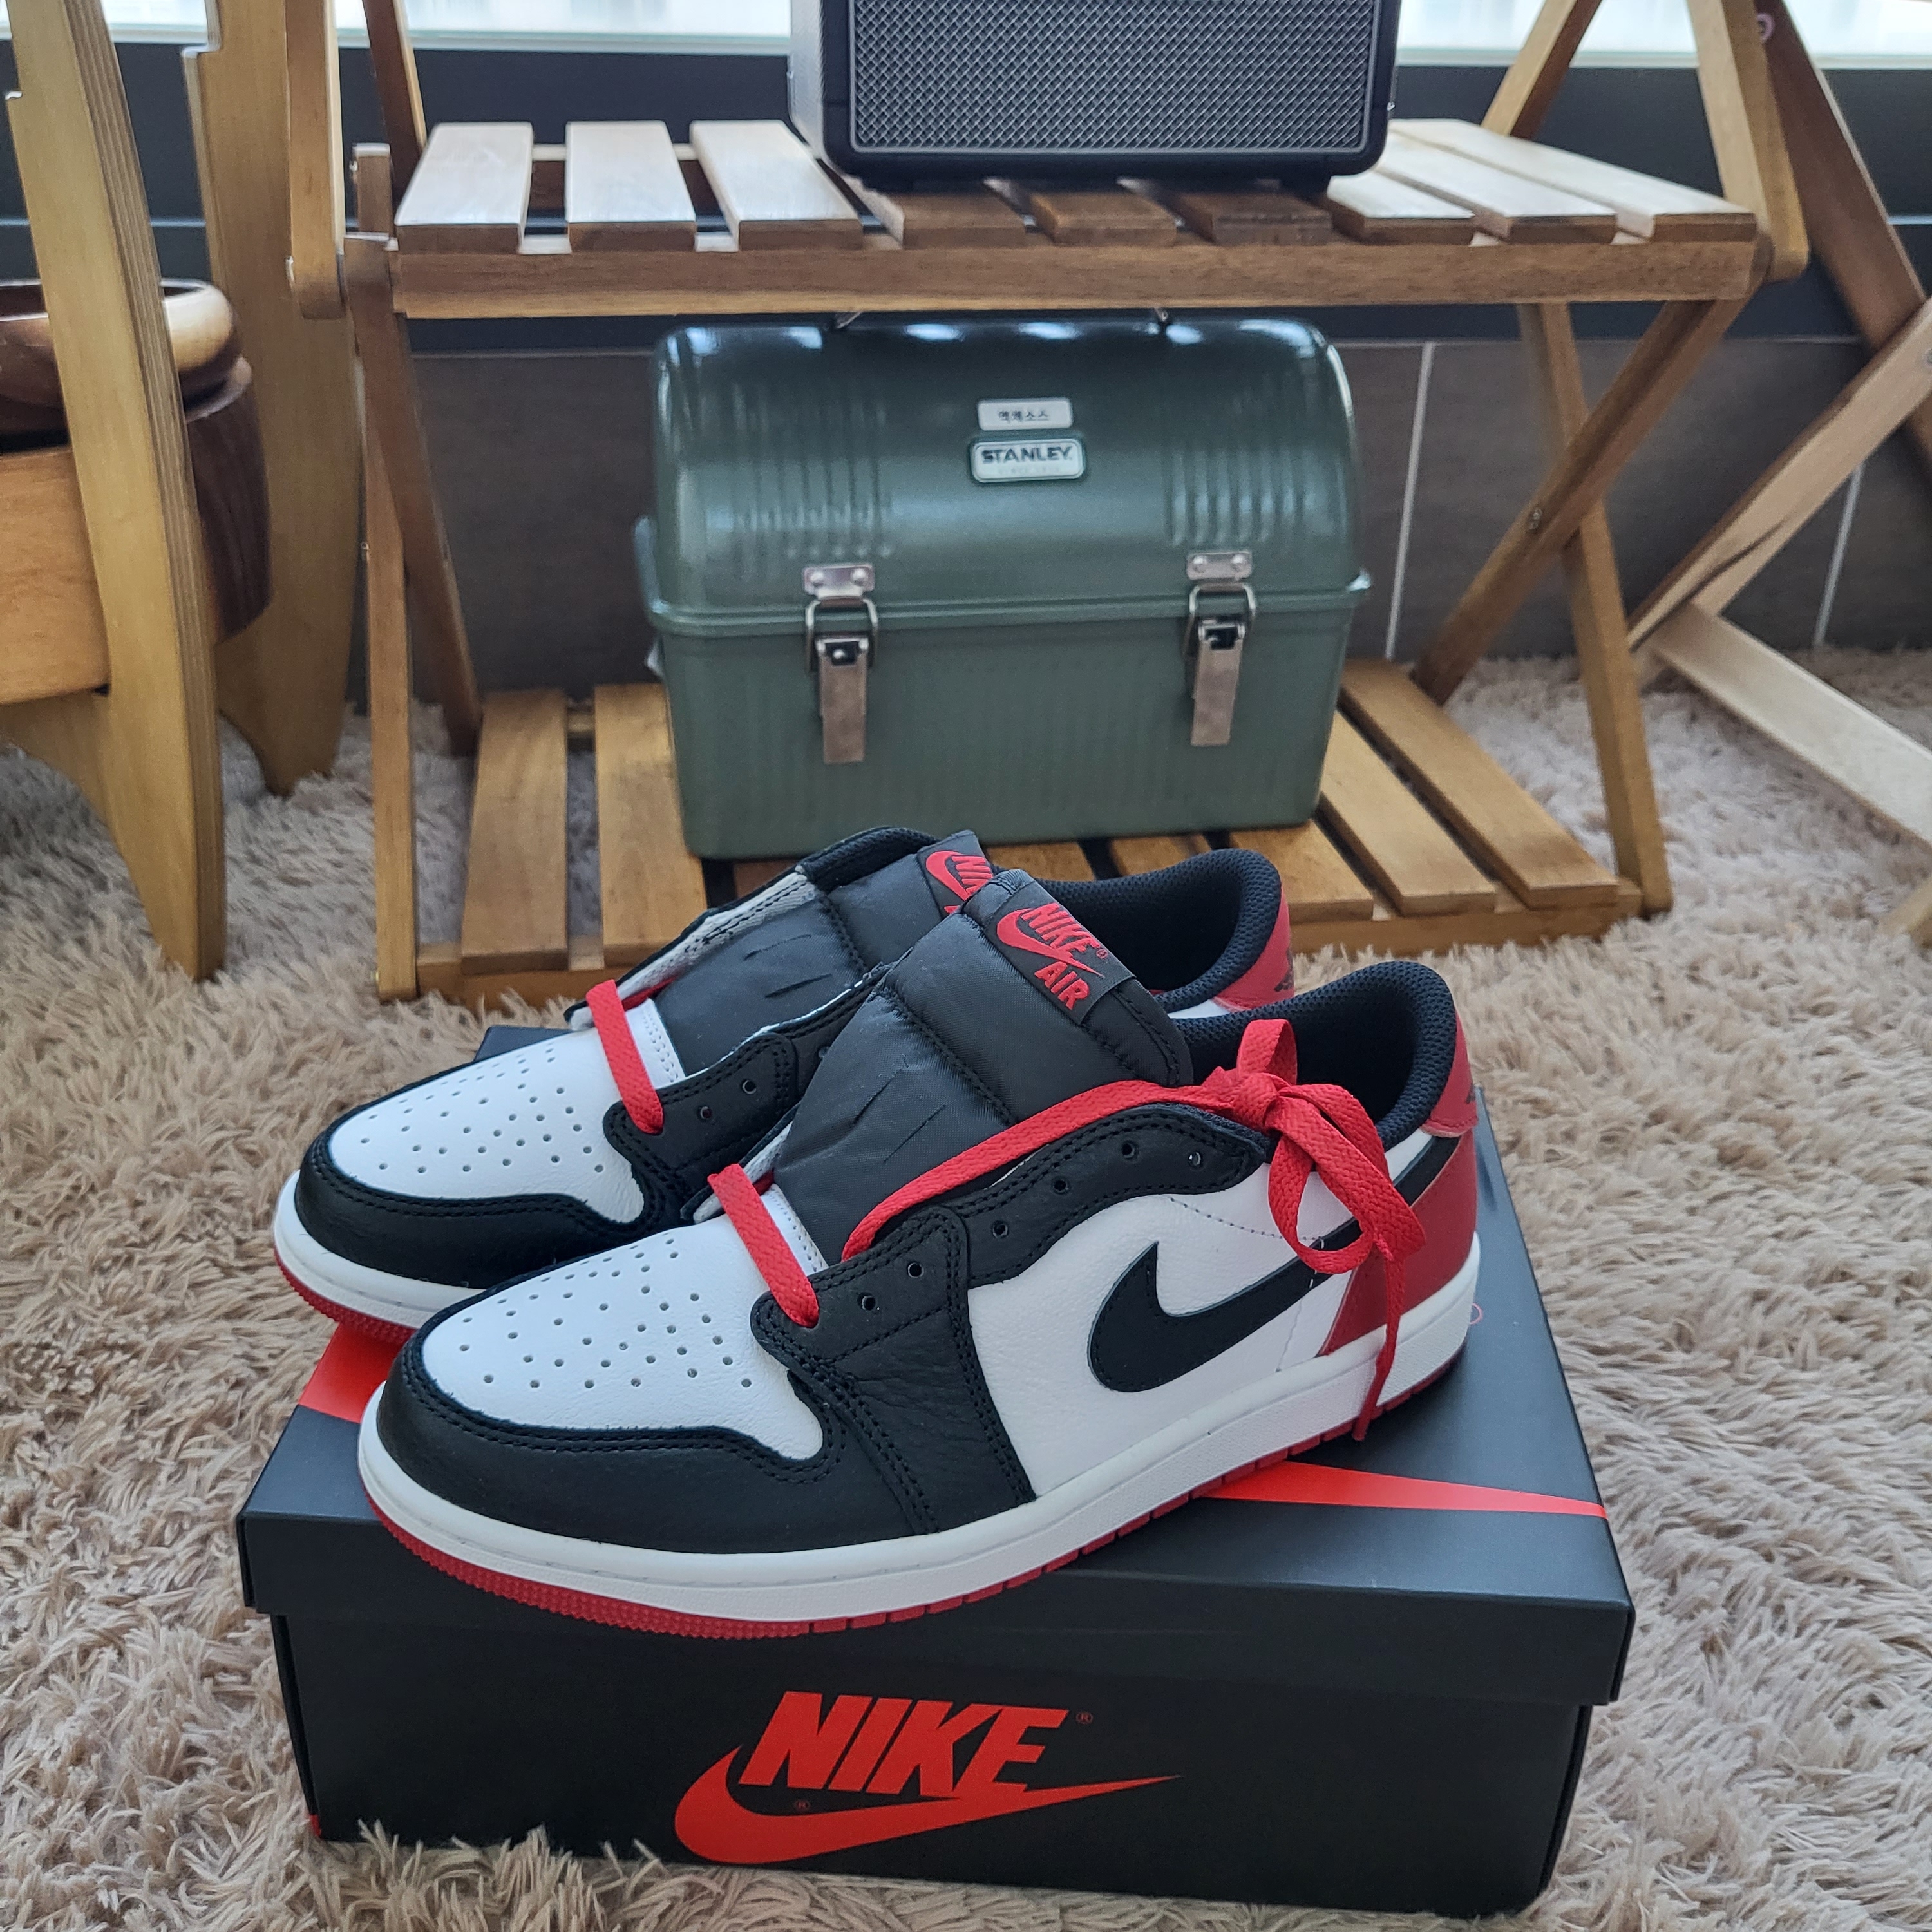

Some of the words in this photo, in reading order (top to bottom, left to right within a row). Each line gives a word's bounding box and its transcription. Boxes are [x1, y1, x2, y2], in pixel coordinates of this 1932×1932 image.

[981, 446, 1072, 464] STANLEY
[951, 855, 993, 895] NIK
[1021, 902, 1101, 952] NIKE
[1034, 961, 1090, 1010] AIR
[738, 1690, 1069, 1800] NIKE
